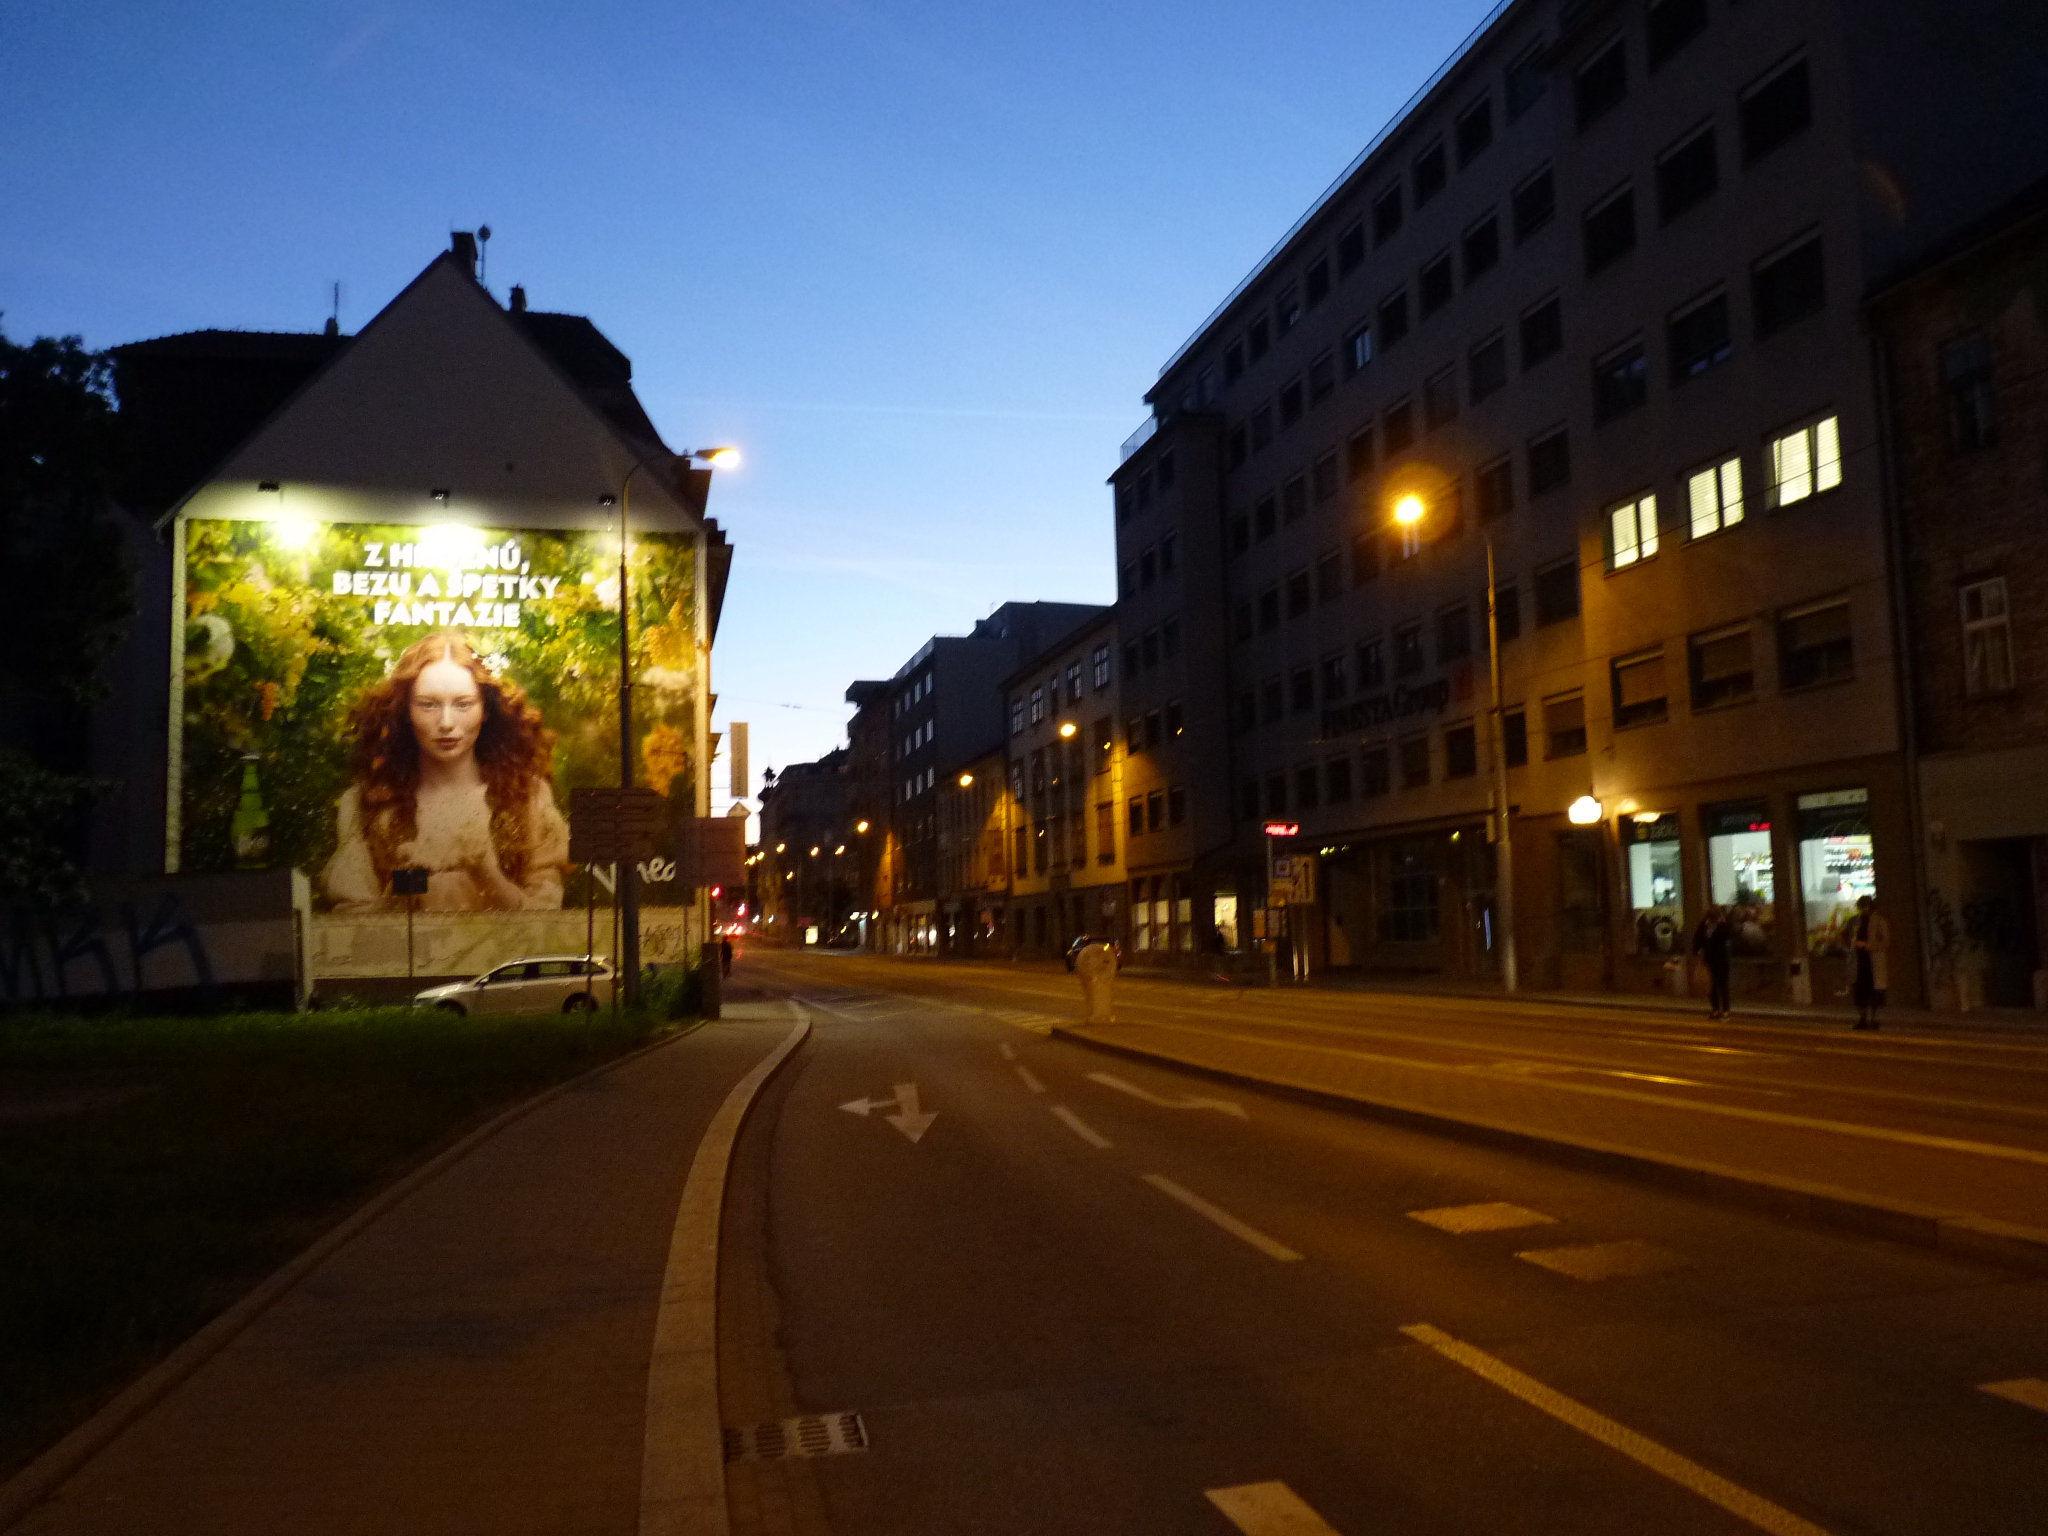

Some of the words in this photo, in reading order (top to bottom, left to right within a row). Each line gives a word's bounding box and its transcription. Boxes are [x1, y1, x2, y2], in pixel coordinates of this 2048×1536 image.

[364, 542, 383, 568] Z
[333, 570, 411, 597] BEZU
[416, 572, 441, 598] A
[374, 601, 521, 628] FANTAZIE
